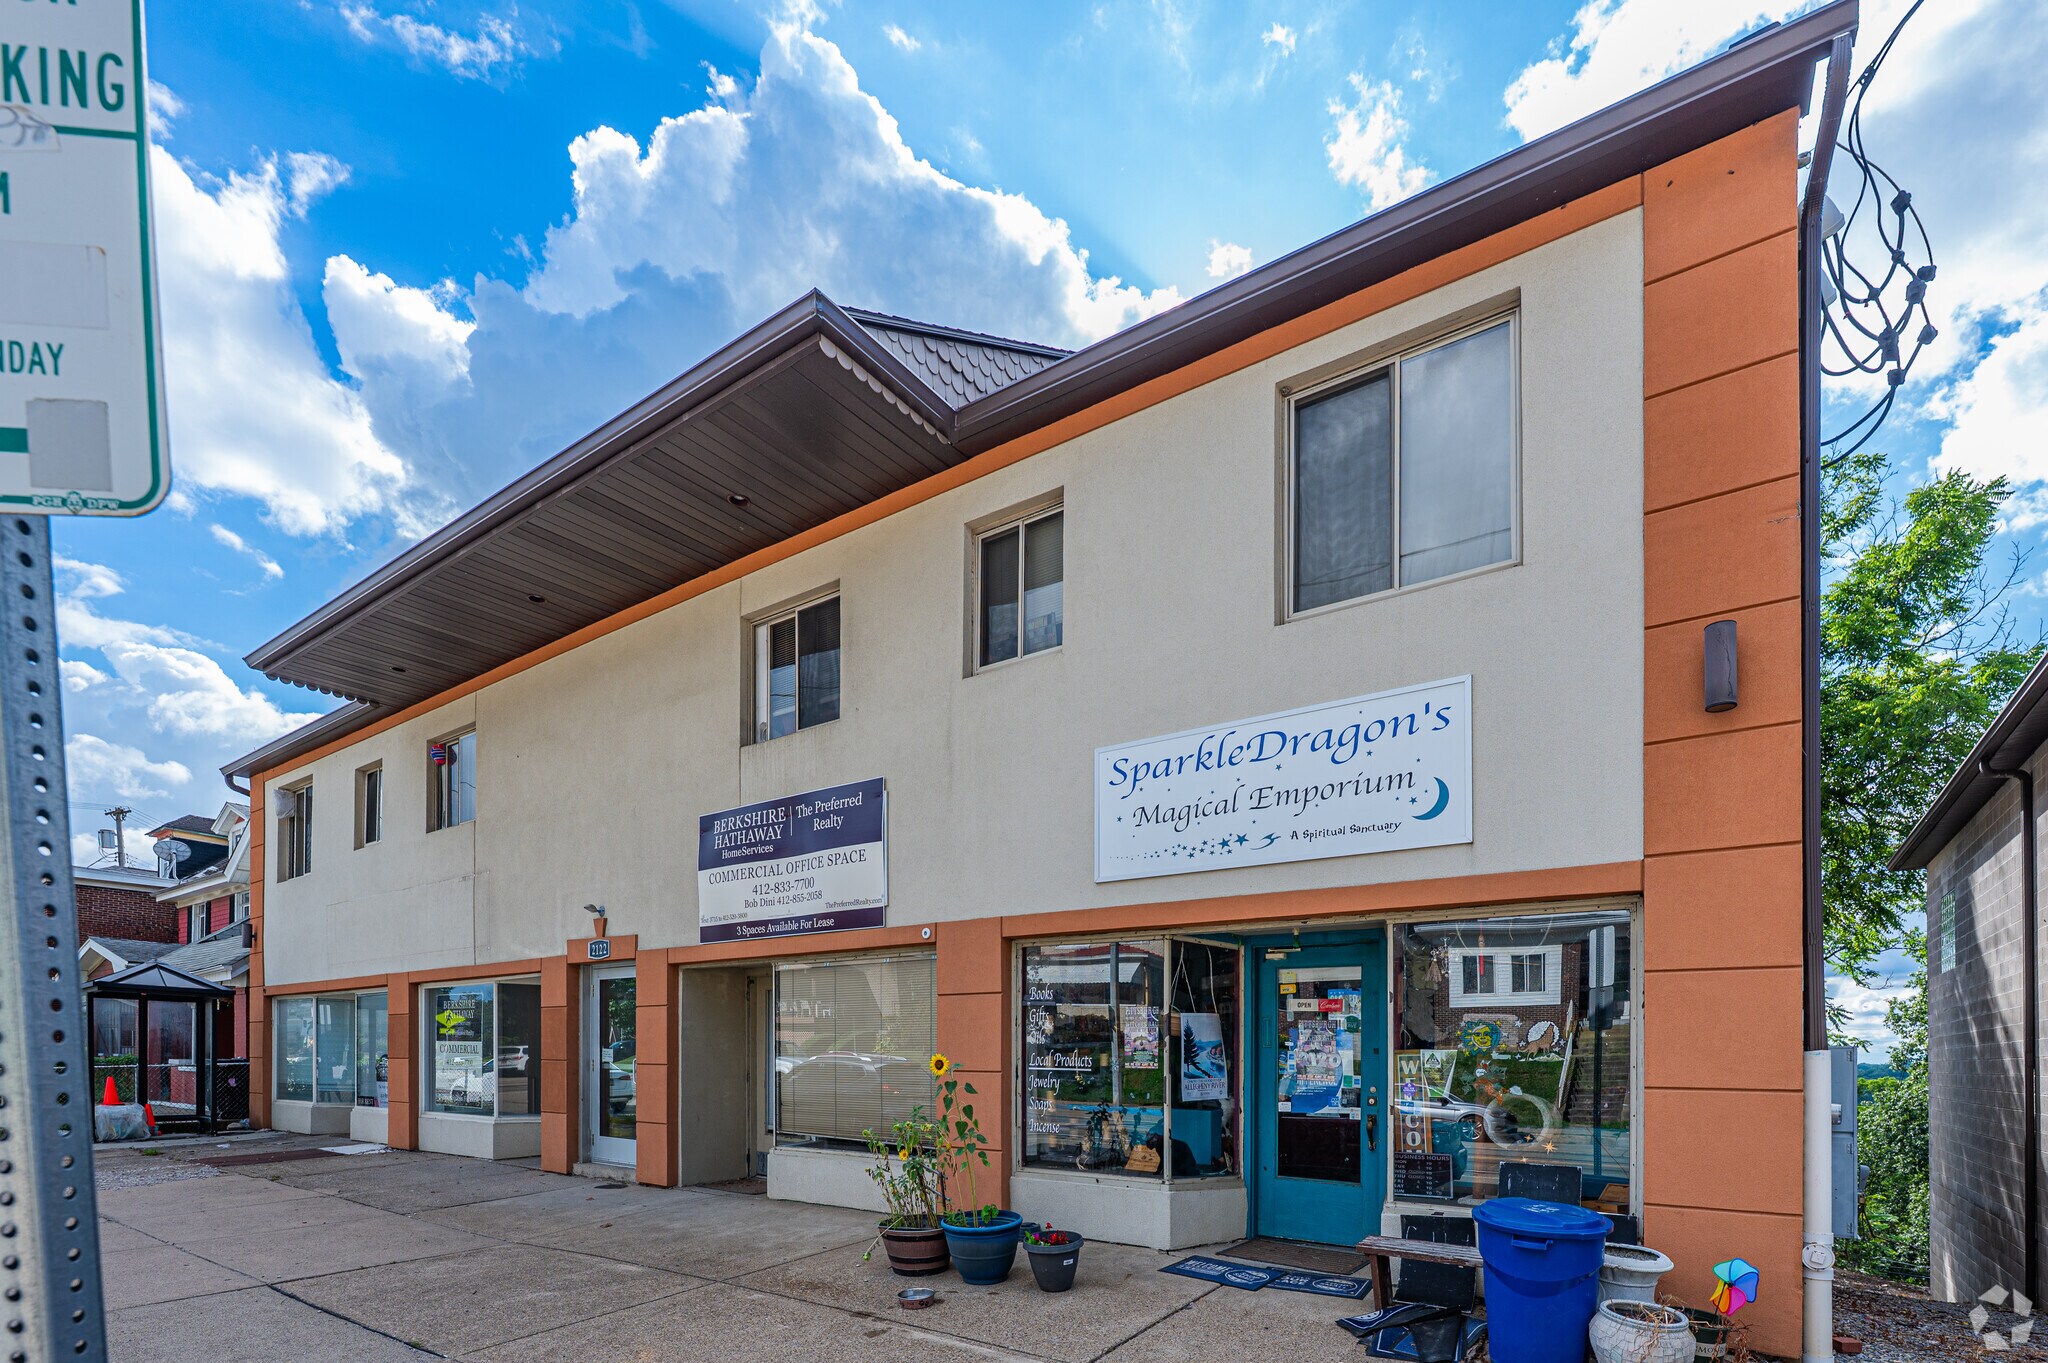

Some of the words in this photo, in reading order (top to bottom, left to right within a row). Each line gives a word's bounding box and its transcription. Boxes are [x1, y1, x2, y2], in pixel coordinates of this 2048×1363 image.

[86, 497, 120, 511] DPW
[1109, 701, 1452, 799] SparkleDragon's
[796, 804, 813, 818] The
[815, 792, 863, 814] Preferred
[1132, 784, 1246, 833] Magical
[1248, 770, 1416, 817] Emporium
[714, 807, 786, 834] BERKSHIRE
[813, 814, 844, 831] Realty
[714, 825, 783, 849] HATHAWAY
[1290, 829, 1299, 840] A
[1302, 823, 1346, 842] Spiritual
[1349, 820, 1402, 835] Sanctuary
[721, 844, 774, 859] HomeServices
[708, 863, 783, 885] COMMERCIAL
[786, 856, 824, 875] OFFICE
[827, 849, 867, 867] SPACE
[752, 877, 815, 896] 412-833-7700
[744, 897, 759, 909] Bob
[759, 896, 776, 908] Dini
[776, 890, 823, 906] 412-855-2058
[736, 926, 742, 936] 3
[742, 923, 766, 937] Spaces
[767, 918, 799, 933] Available
[800, 919, 813, 929] For
[813, 917, 835, 928] Lease
[591, 943, 607, 956] 2122
[1029, 986, 1054, 1000] Books
[443, 1000, 475, 1009] BERKSHIRE
[1029, 1007, 1050, 1027] Gifts
[440, 1043, 479, 1055] COMMERCIAL
[1029, 1051, 1052, 1067] Local
[1053, 1051, 1093, 1068] Products
[1028, 1073, 1061, 1096] Jewelry
[1029, 1097, 1053, 1117] Soaps
[1029, 1119, 1060, 1134] Incense
